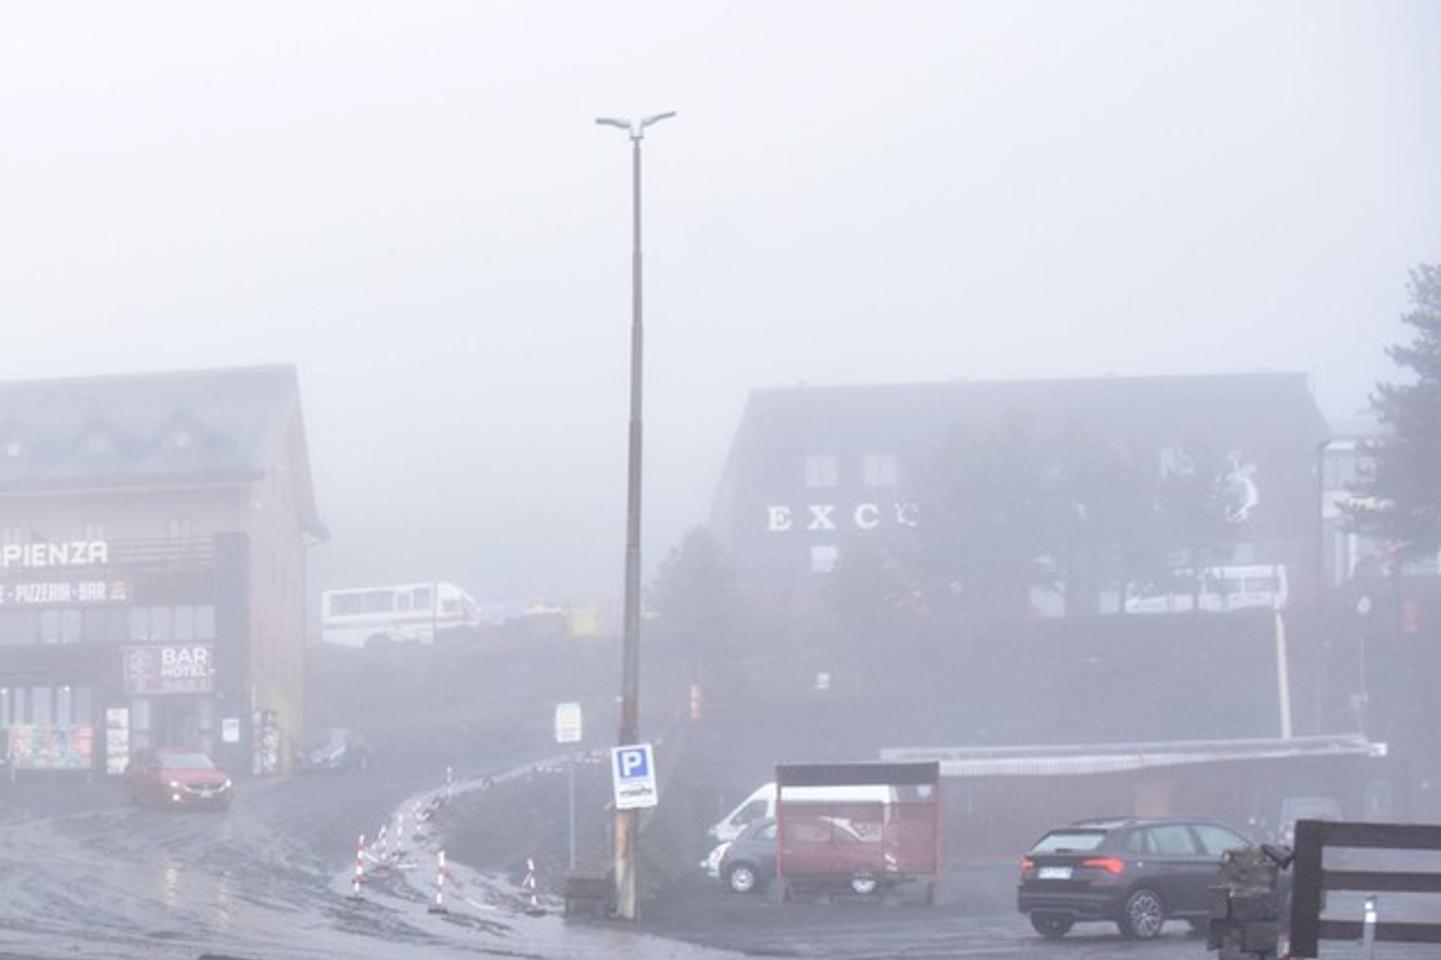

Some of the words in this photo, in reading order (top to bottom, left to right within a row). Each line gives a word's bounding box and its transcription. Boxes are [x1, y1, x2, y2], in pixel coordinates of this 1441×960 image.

[15, 581, 71, 604] PIZZERIA
[78, 580, 106, 601] BAR
[161, 647, 207, 665] BAR
[622, 751, 643, 776] P
